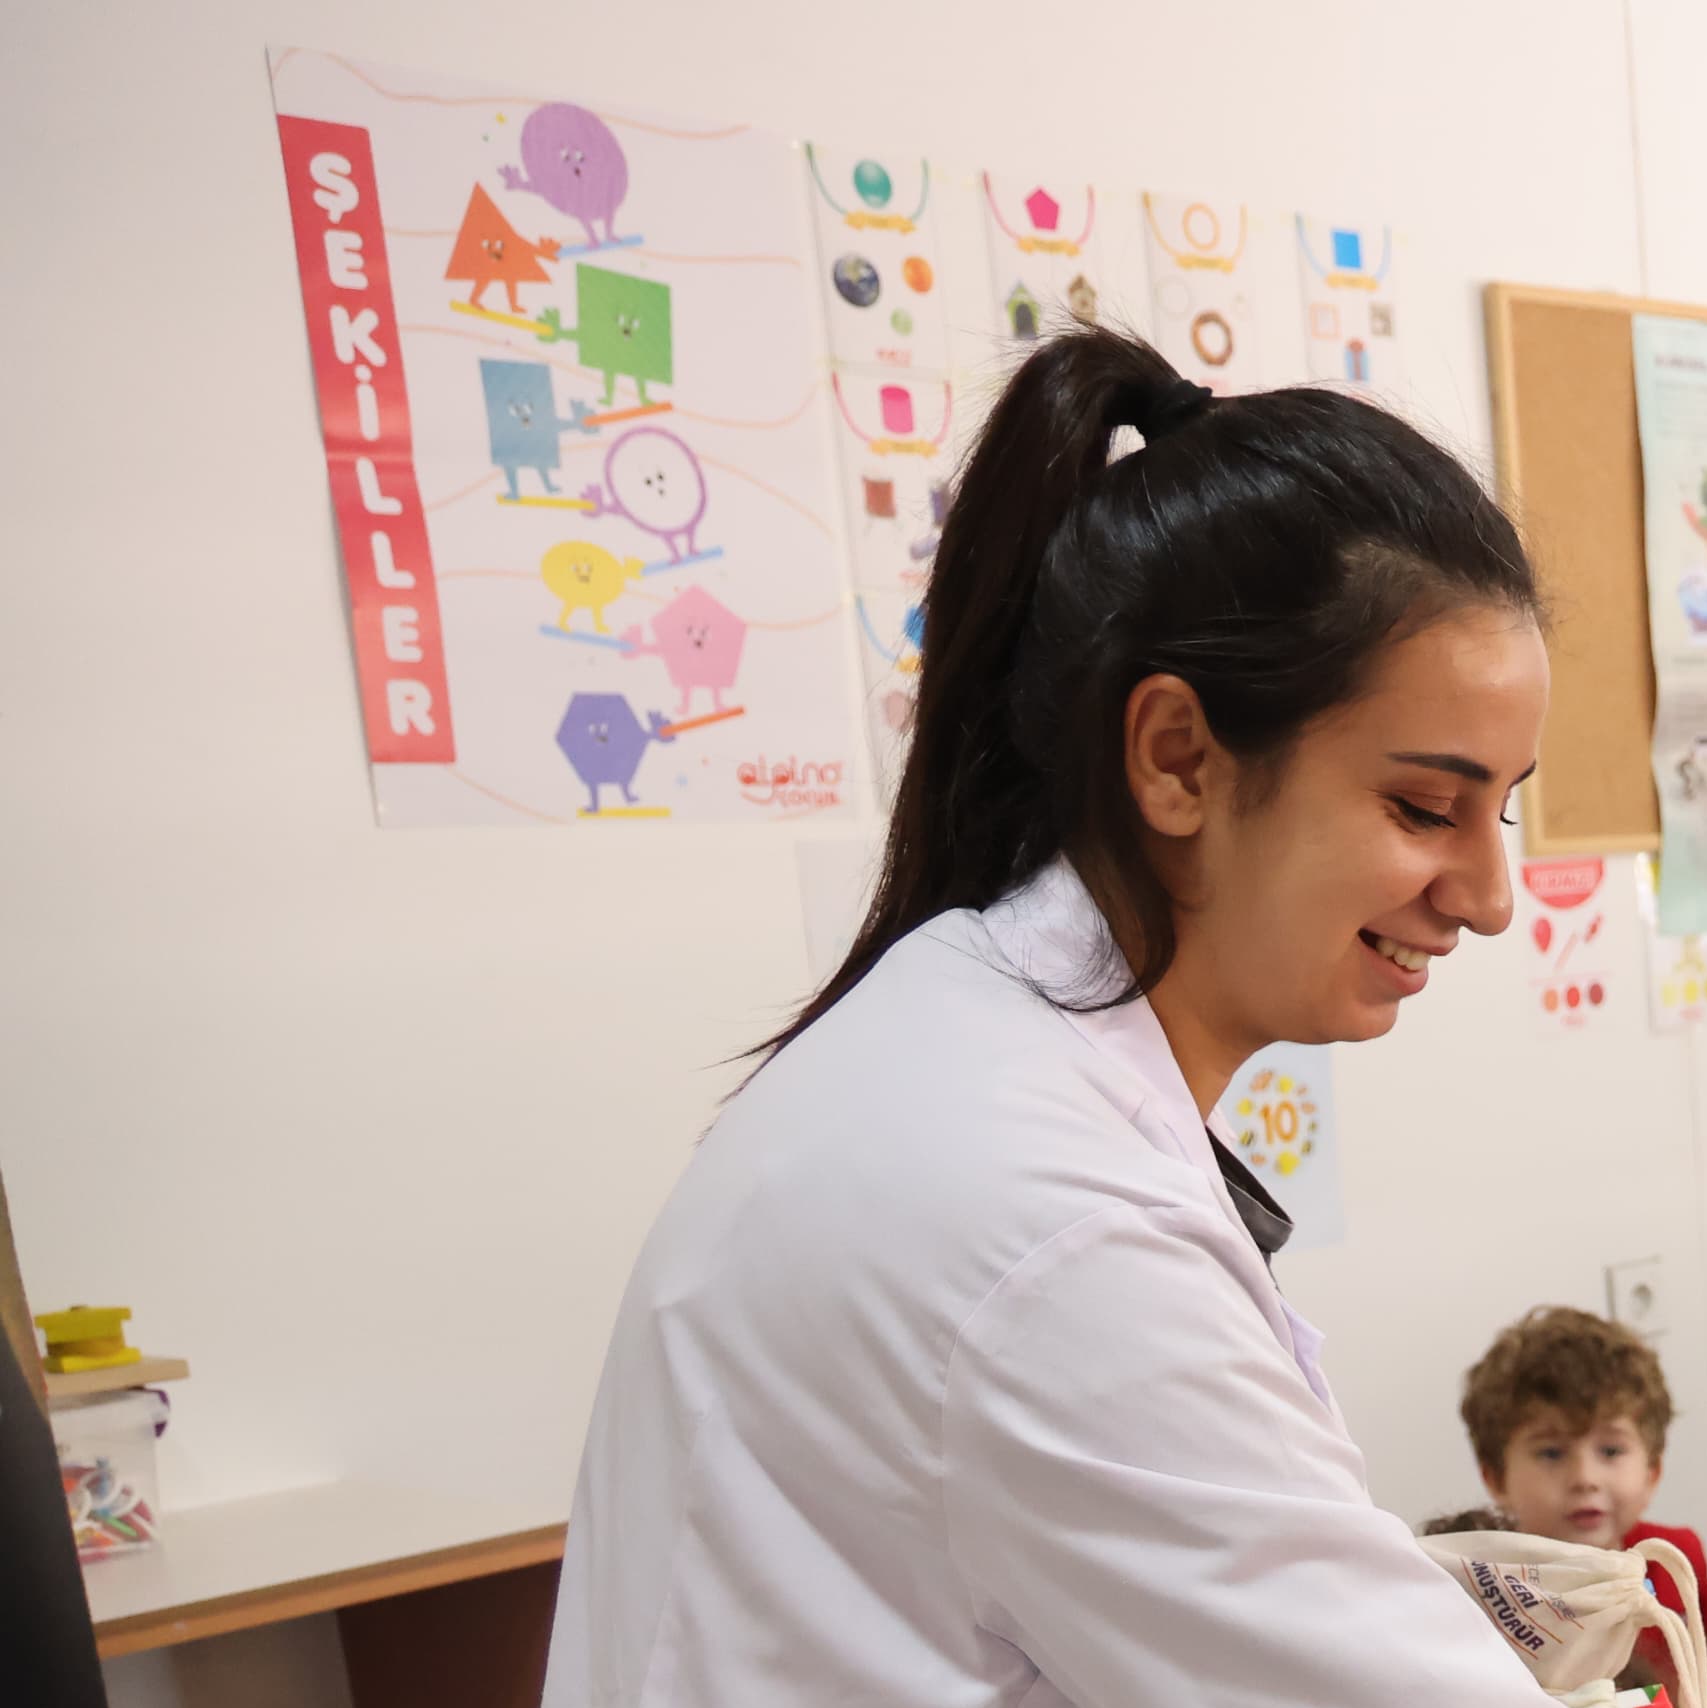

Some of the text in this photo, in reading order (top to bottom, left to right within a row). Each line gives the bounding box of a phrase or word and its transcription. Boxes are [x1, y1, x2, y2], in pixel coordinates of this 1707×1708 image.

[308, 152, 437, 737] ŞEKİLLER
[1259, 1100, 1300, 1146] 10
[1472, 1561, 1545, 1651] NÜŞTÜRÜR
[1504, 1574, 1544, 1609] GERİ
